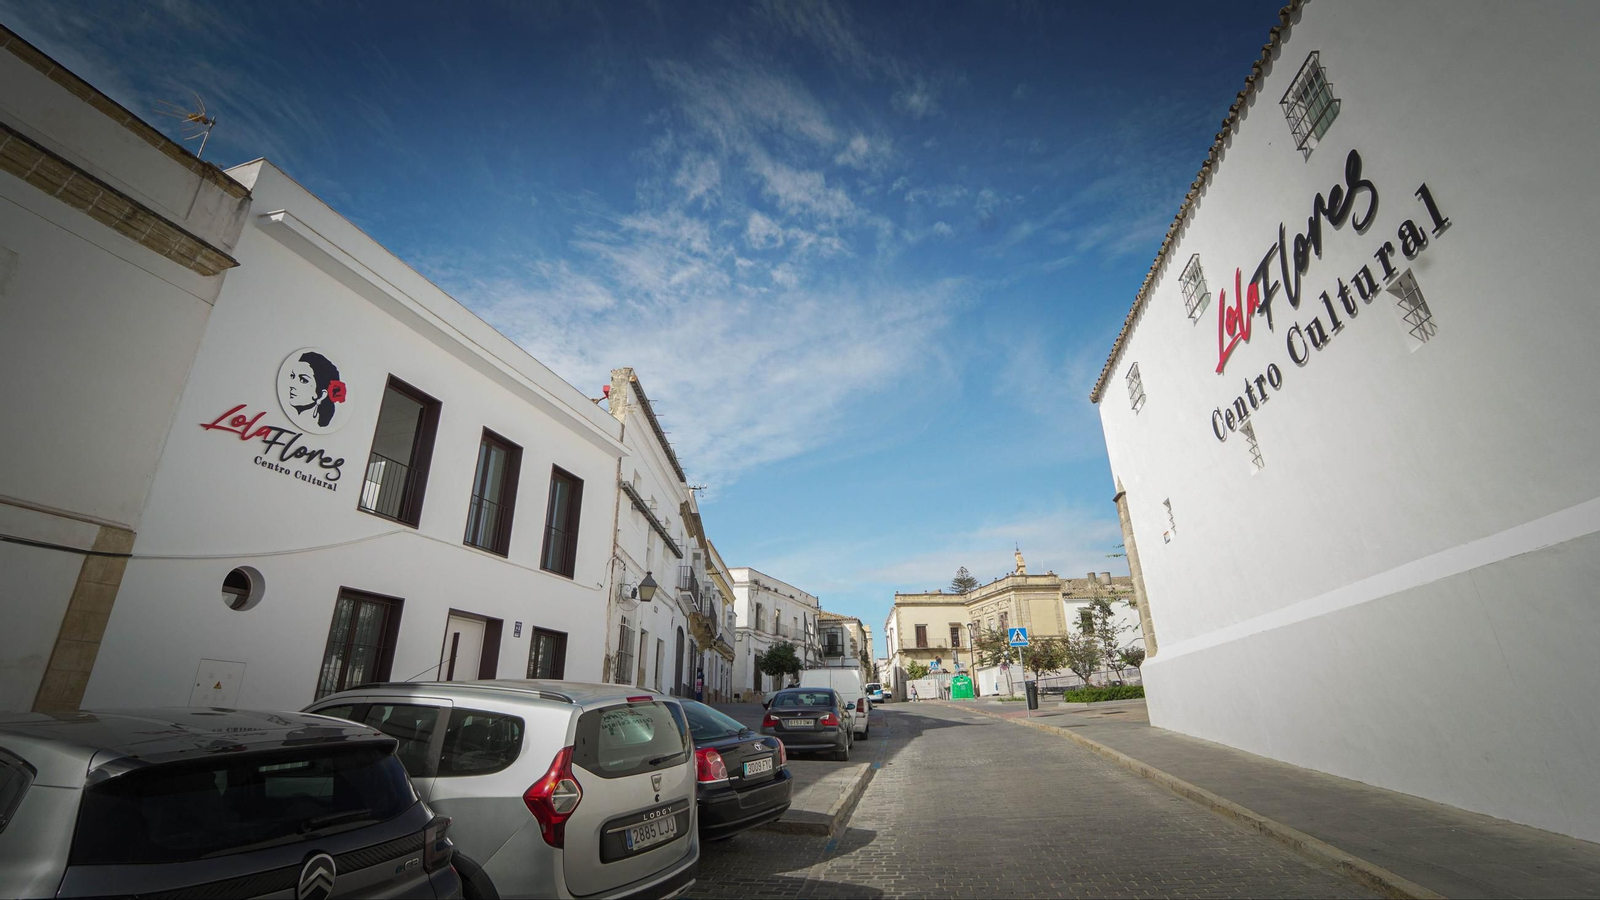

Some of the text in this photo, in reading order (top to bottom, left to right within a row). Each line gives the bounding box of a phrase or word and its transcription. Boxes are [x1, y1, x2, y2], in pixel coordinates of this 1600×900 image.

[1215, 148, 1380, 374] Lola Flores
[1211, 182, 1452, 442] Centro Cultural
[199, 404, 345, 482] Lola Flores
[253, 455, 338, 492] Centro Cultural
[633, 817, 675, 844] 2885 LJJ
[643, 806, 672, 821] LODGY
